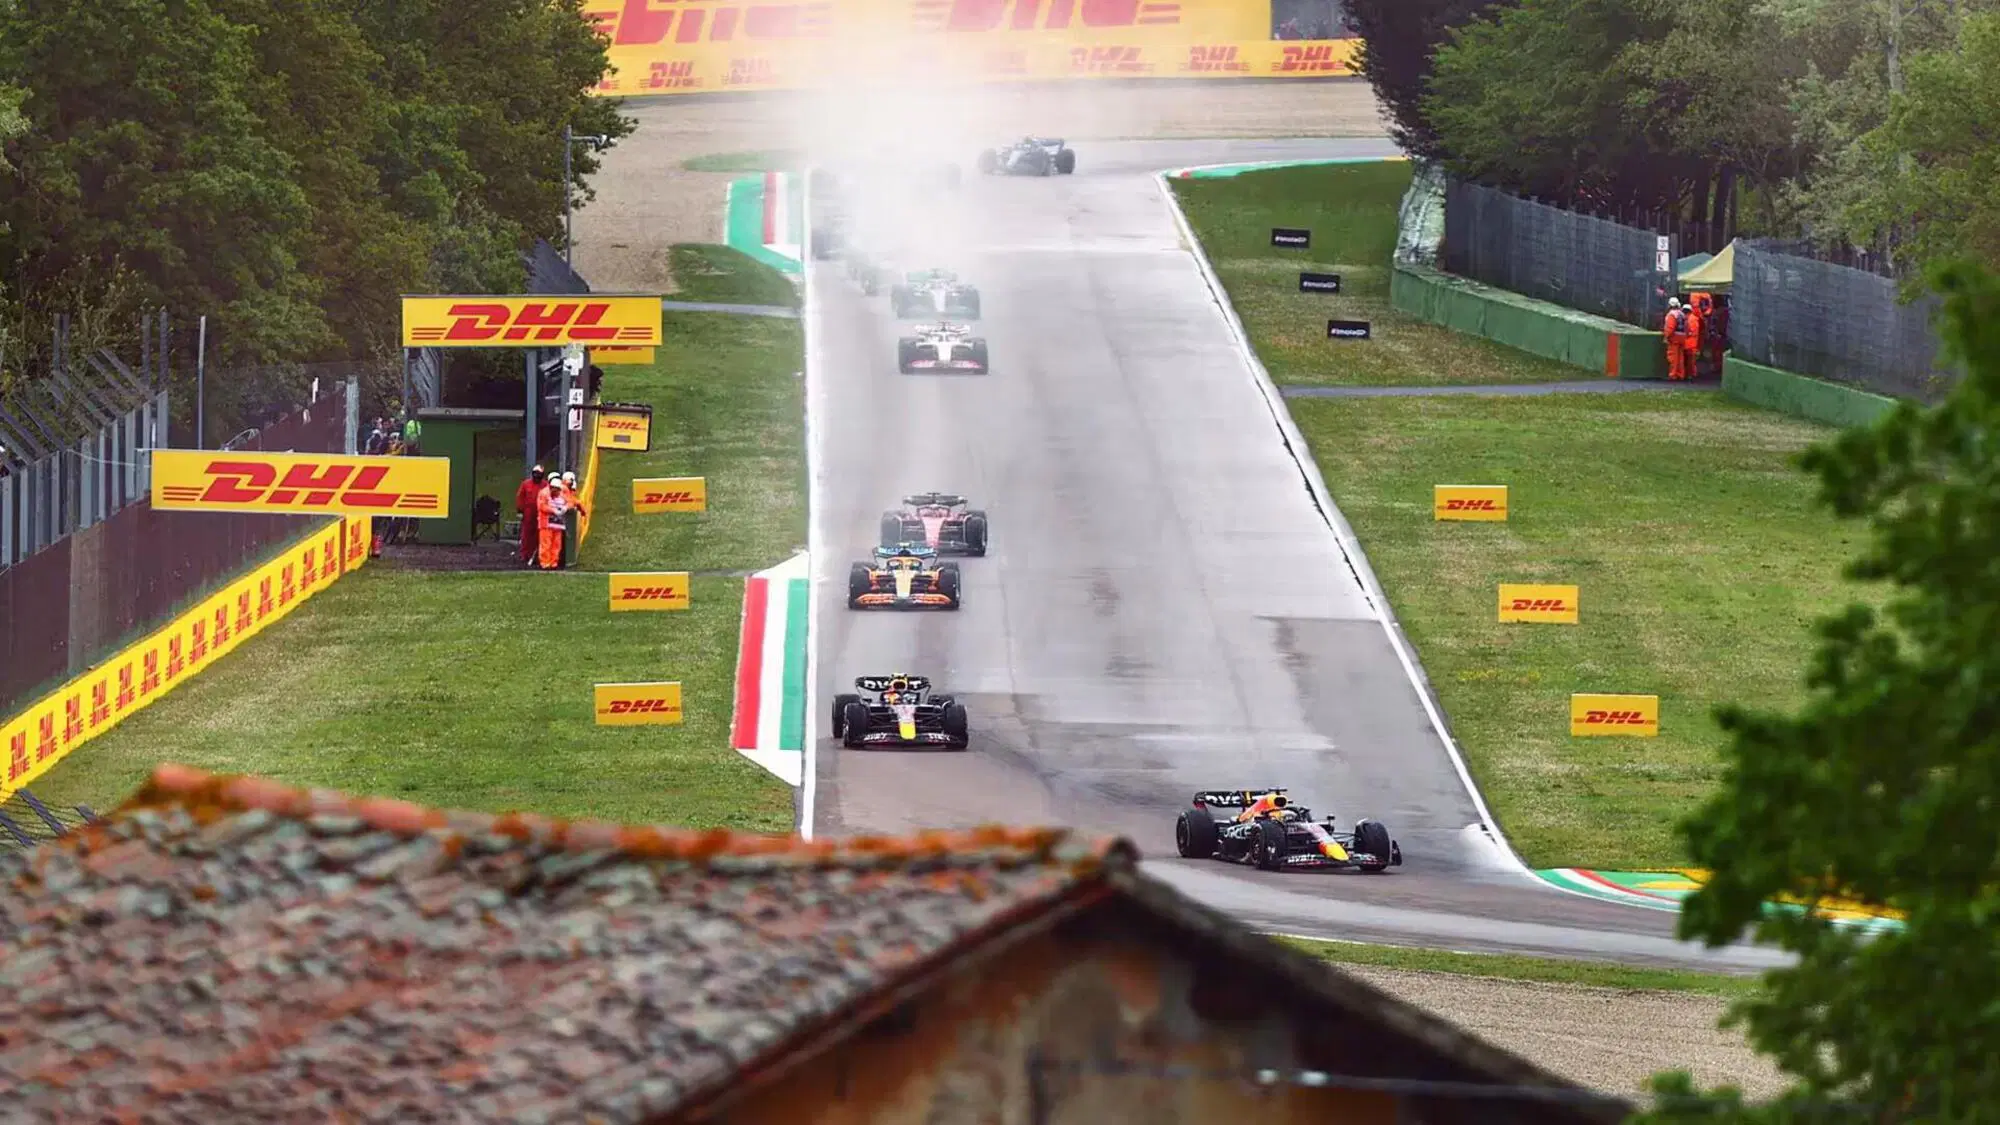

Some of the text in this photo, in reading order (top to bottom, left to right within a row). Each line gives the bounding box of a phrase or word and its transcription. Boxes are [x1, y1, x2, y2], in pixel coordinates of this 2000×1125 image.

[1281, 46, 1336, 71] DHL
[444, 304, 619, 340] DHL
[607, 420, 641, 431] DHL
[200, 461, 400, 507] DHL
[643, 491, 695, 504] DHL
[1446, 499, 1496, 511] DHL
[622, 587, 676, 600] DHL
[1511, 599, 1567, 611] DHL
[609, 699, 669, 713] DHL
[1585, 710, 1645, 724] DHL
